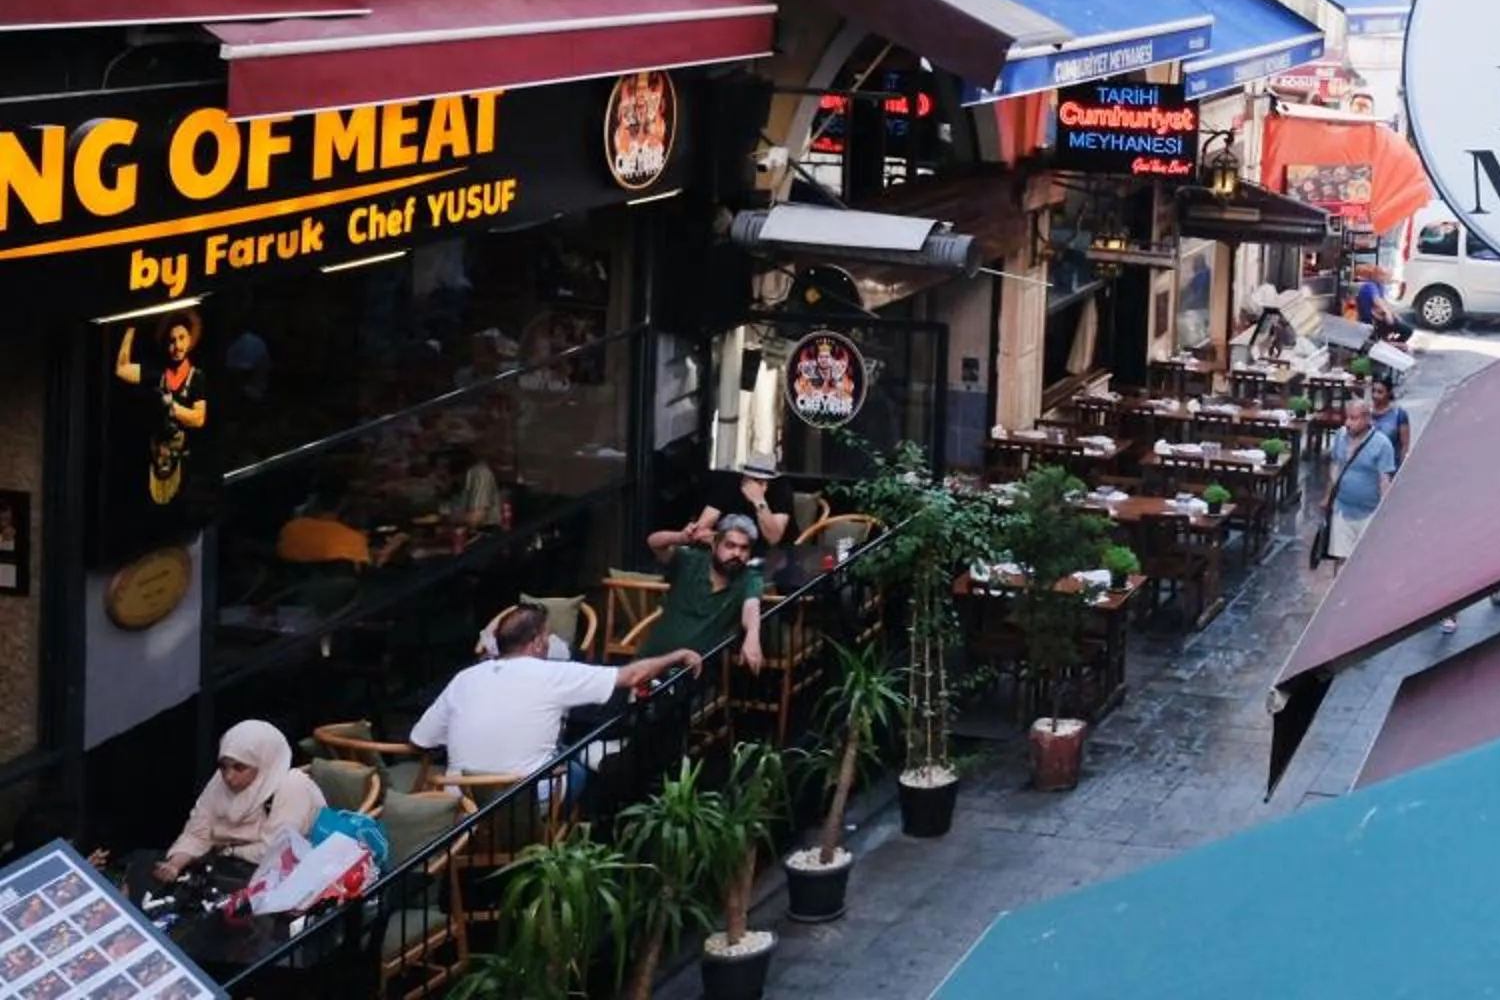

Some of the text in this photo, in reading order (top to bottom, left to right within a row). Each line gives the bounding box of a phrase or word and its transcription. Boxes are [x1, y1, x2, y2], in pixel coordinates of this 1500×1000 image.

[1097, 86, 1160, 105] TARİHİ
[169, 107, 295, 200] OF
[312, 90, 505, 181] MEAT
[1069, 132, 1183, 154] MEYHANESİ
[129, 179, 516, 298] by Faruk Chef YUSUF
